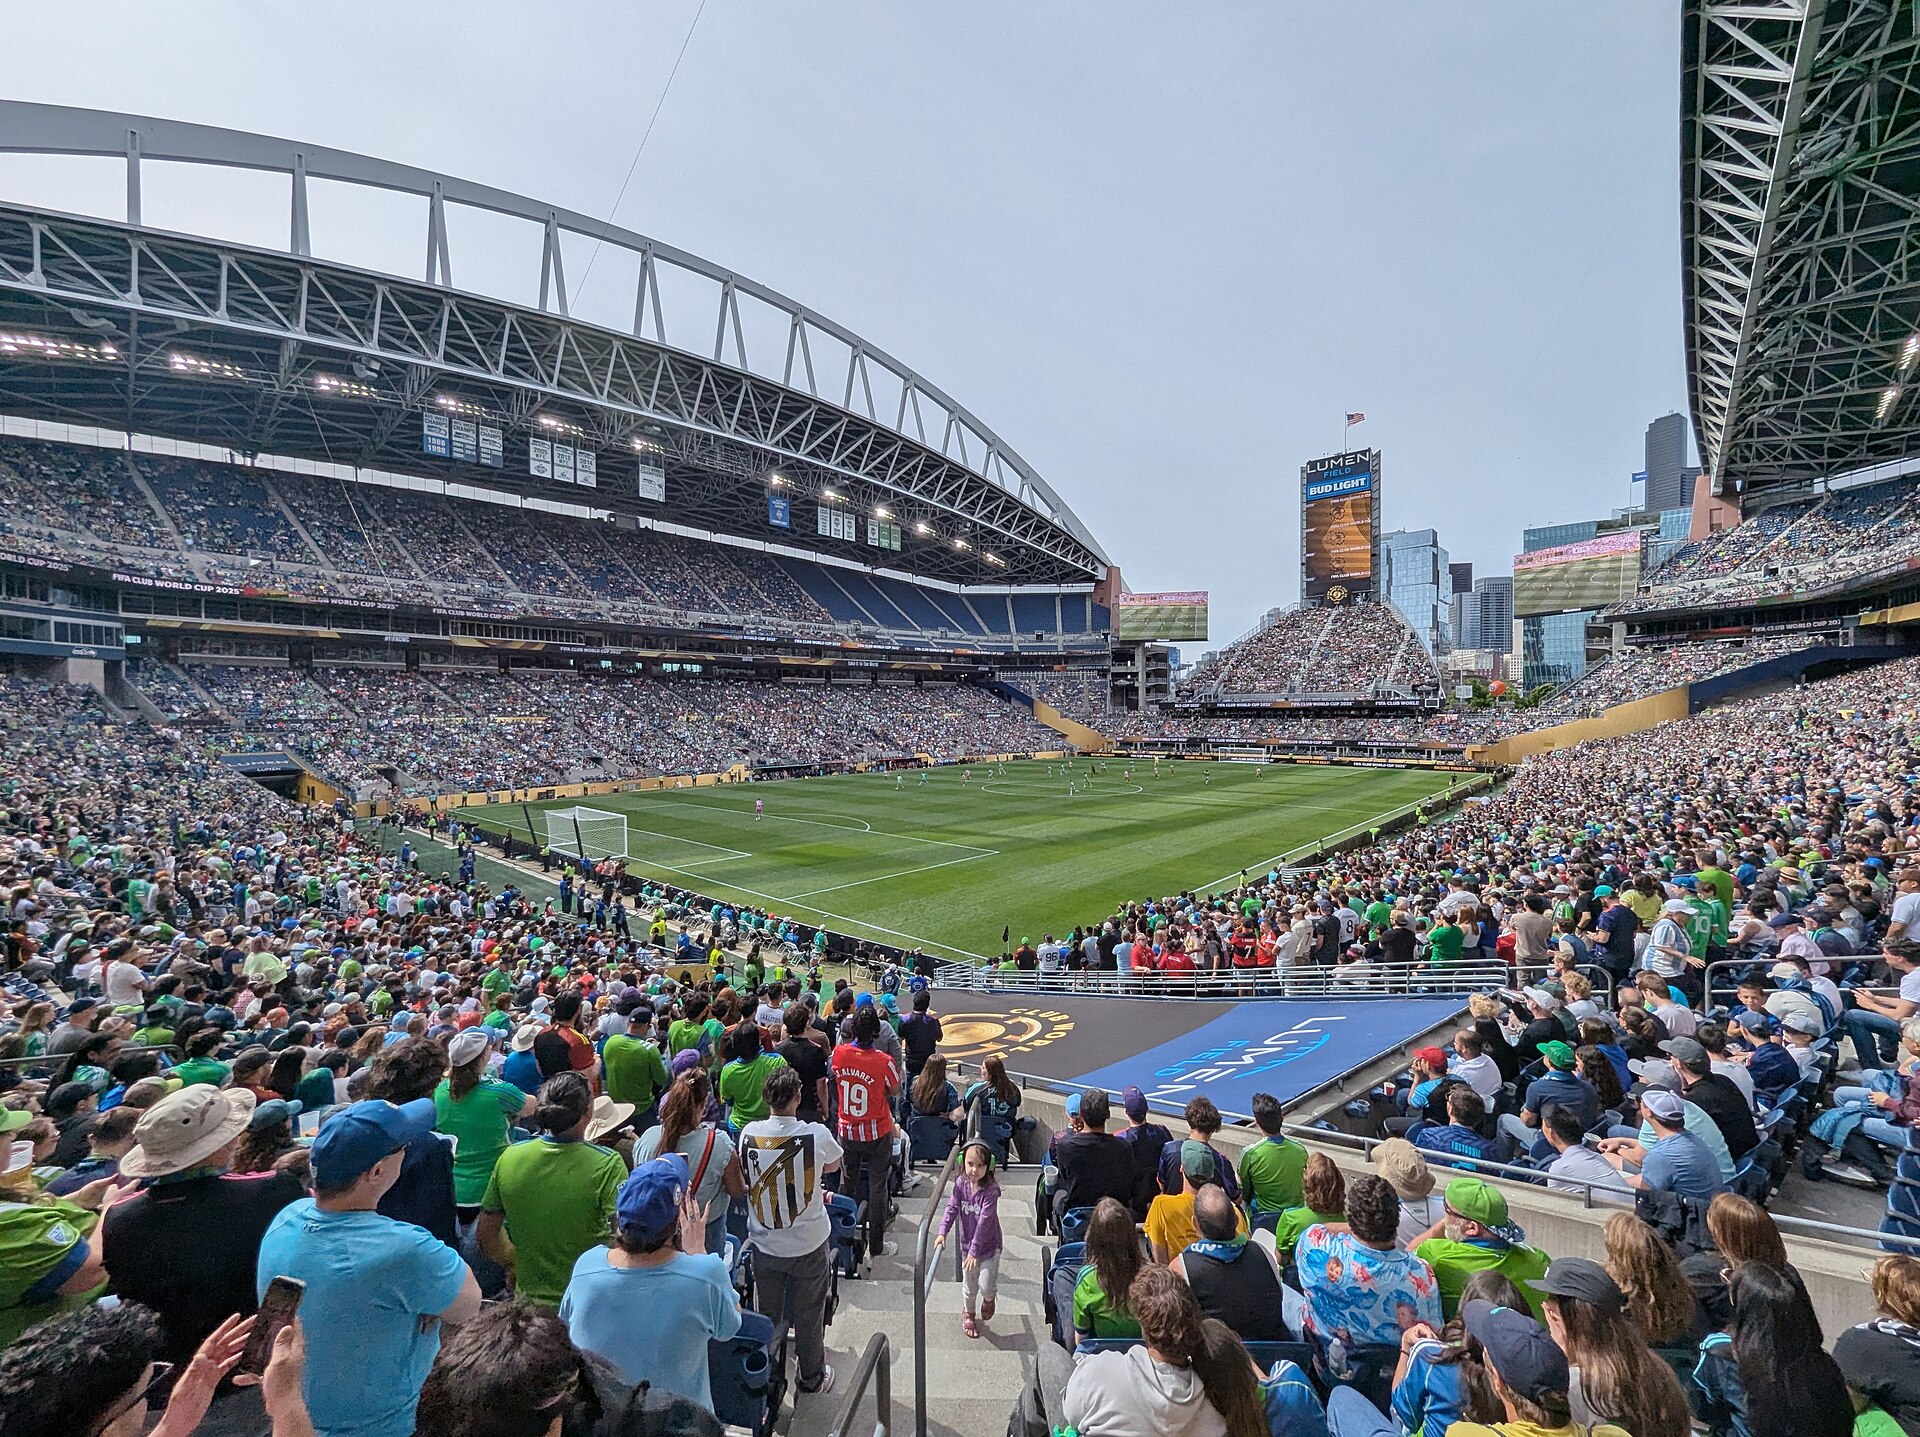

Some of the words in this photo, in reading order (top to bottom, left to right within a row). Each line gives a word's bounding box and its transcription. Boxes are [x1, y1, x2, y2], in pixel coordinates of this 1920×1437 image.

[1307, 451, 1370, 474] LUMEN
[1323, 467, 1352, 478] FIELD
[1309, 484, 1332, 496] BUD
[1334, 477, 1367, 491] LIGHT
[0, 552, 25, 564] ORLD
[26, 557, 46, 567] CUP
[112, 573, 131, 584] FIFA
[132, 576, 154, 586] CLUB
[155, 580, 192, 590] WORLD
[194, 584, 214, 592] CUP
[331, 598, 360, 606] WORLD
[1346, 920, 1354, 934] 8
[1693, 916, 1710, 934] 10
[1244, 945, 1252, 959] 7
[1009, 1008, 1070, 1022] CLUB
[1144, 1016, 1347, 1099] LUMEN
[1155, 1040, 1250, 1076] FIELD
[840, 1080, 868, 1117] 19
